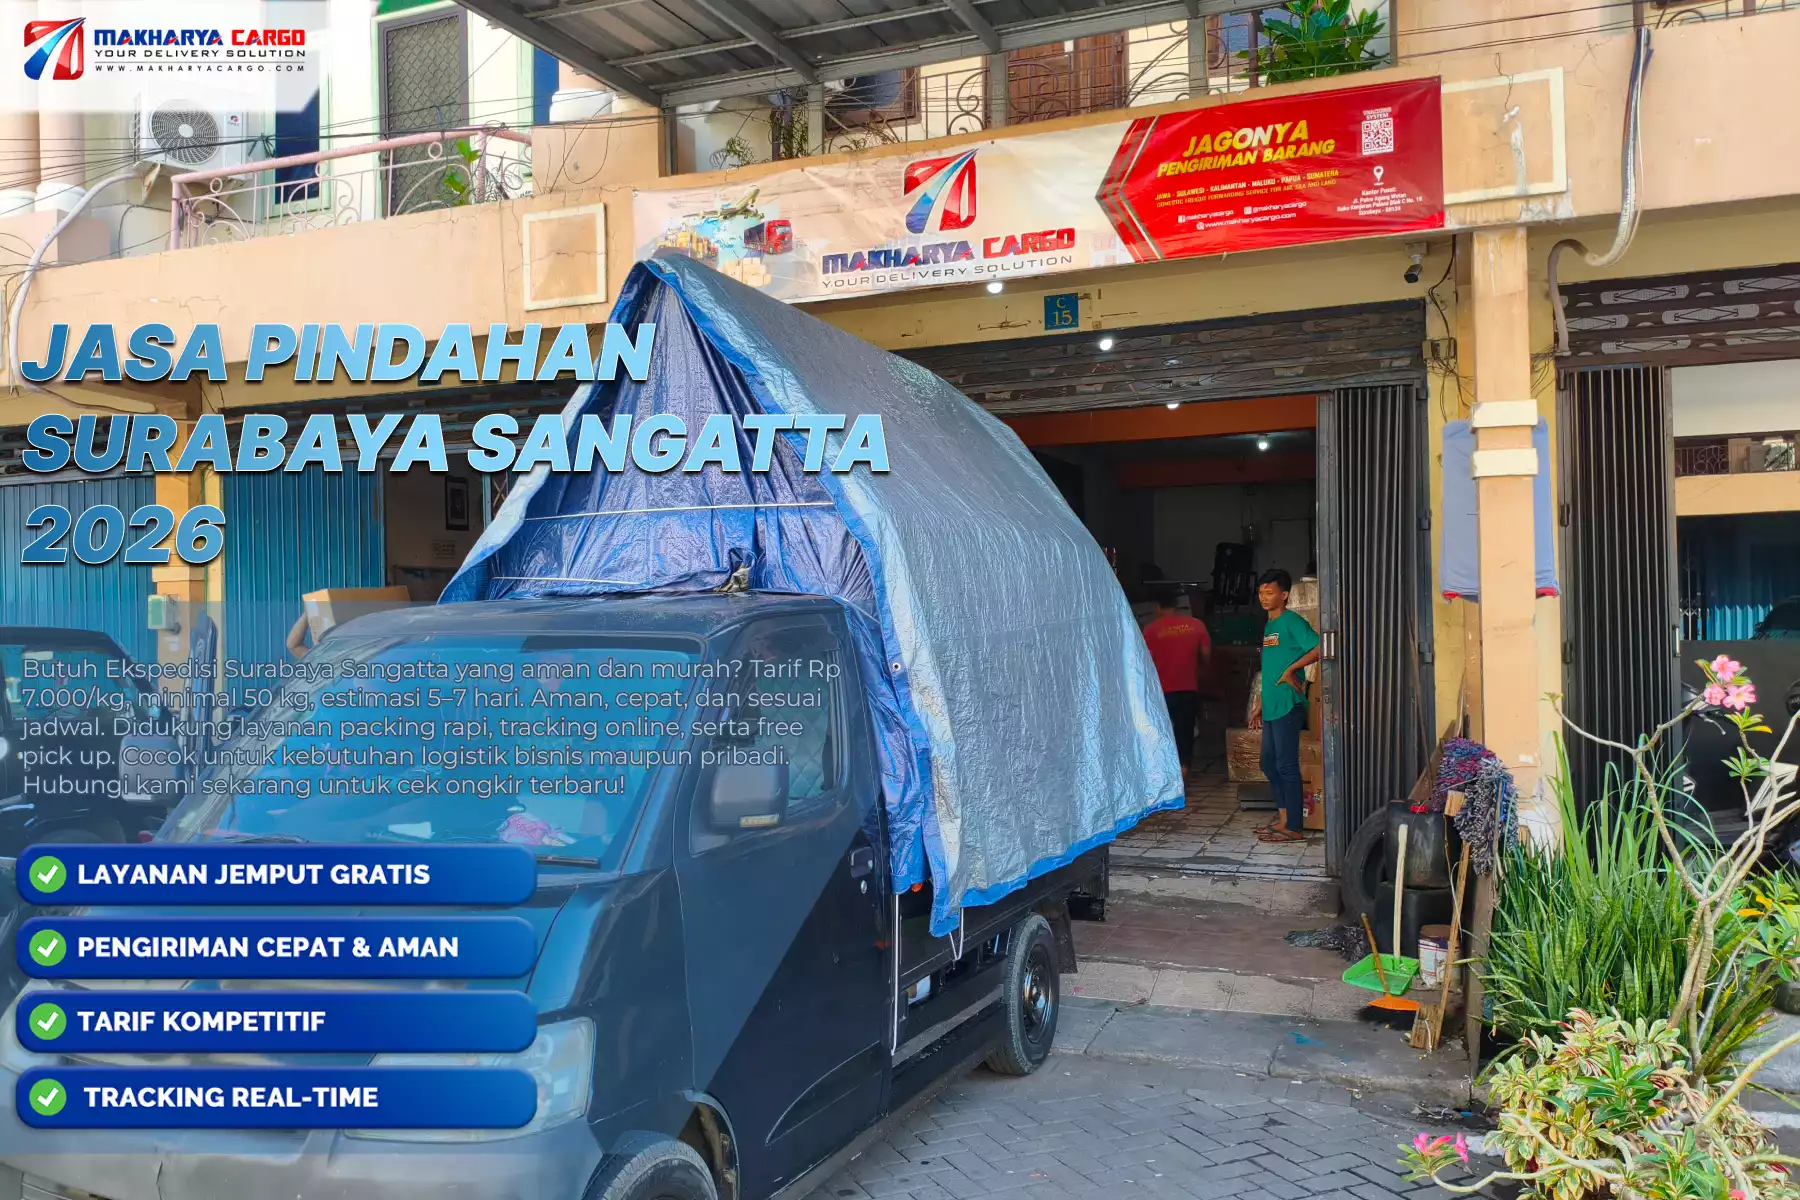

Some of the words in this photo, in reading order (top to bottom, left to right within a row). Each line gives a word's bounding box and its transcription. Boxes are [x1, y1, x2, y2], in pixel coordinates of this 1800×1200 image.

[1183, 119, 1309, 158] JAGONYA
[1157, 149, 1258, 178] PENGIRIMAN
[1262, 139, 1336, 163] BARANG
[1155, 192, 1171, 201] JAWA
[1176, 187, 1205, 198] SULAWESI
[1210, 181, 1247, 192] KALIMANTAN
[1252, 178, 1276, 187] MALUKU
[1281, 175, 1301, 184] PAPUA
[1306, 169, 1339, 180] SUMATERA
[822, 240, 975, 275] MAKHARYA
[982, 228, 1075, 259] CARGO
[822, 275, 870, 289] YOUR
[876, 267, 967, 283] DELIVERY
[974, 255, 1072, 275] SOLUTION
[1052, 310, 1073, 325] 15
[1056, 297, 1067, 309] C
